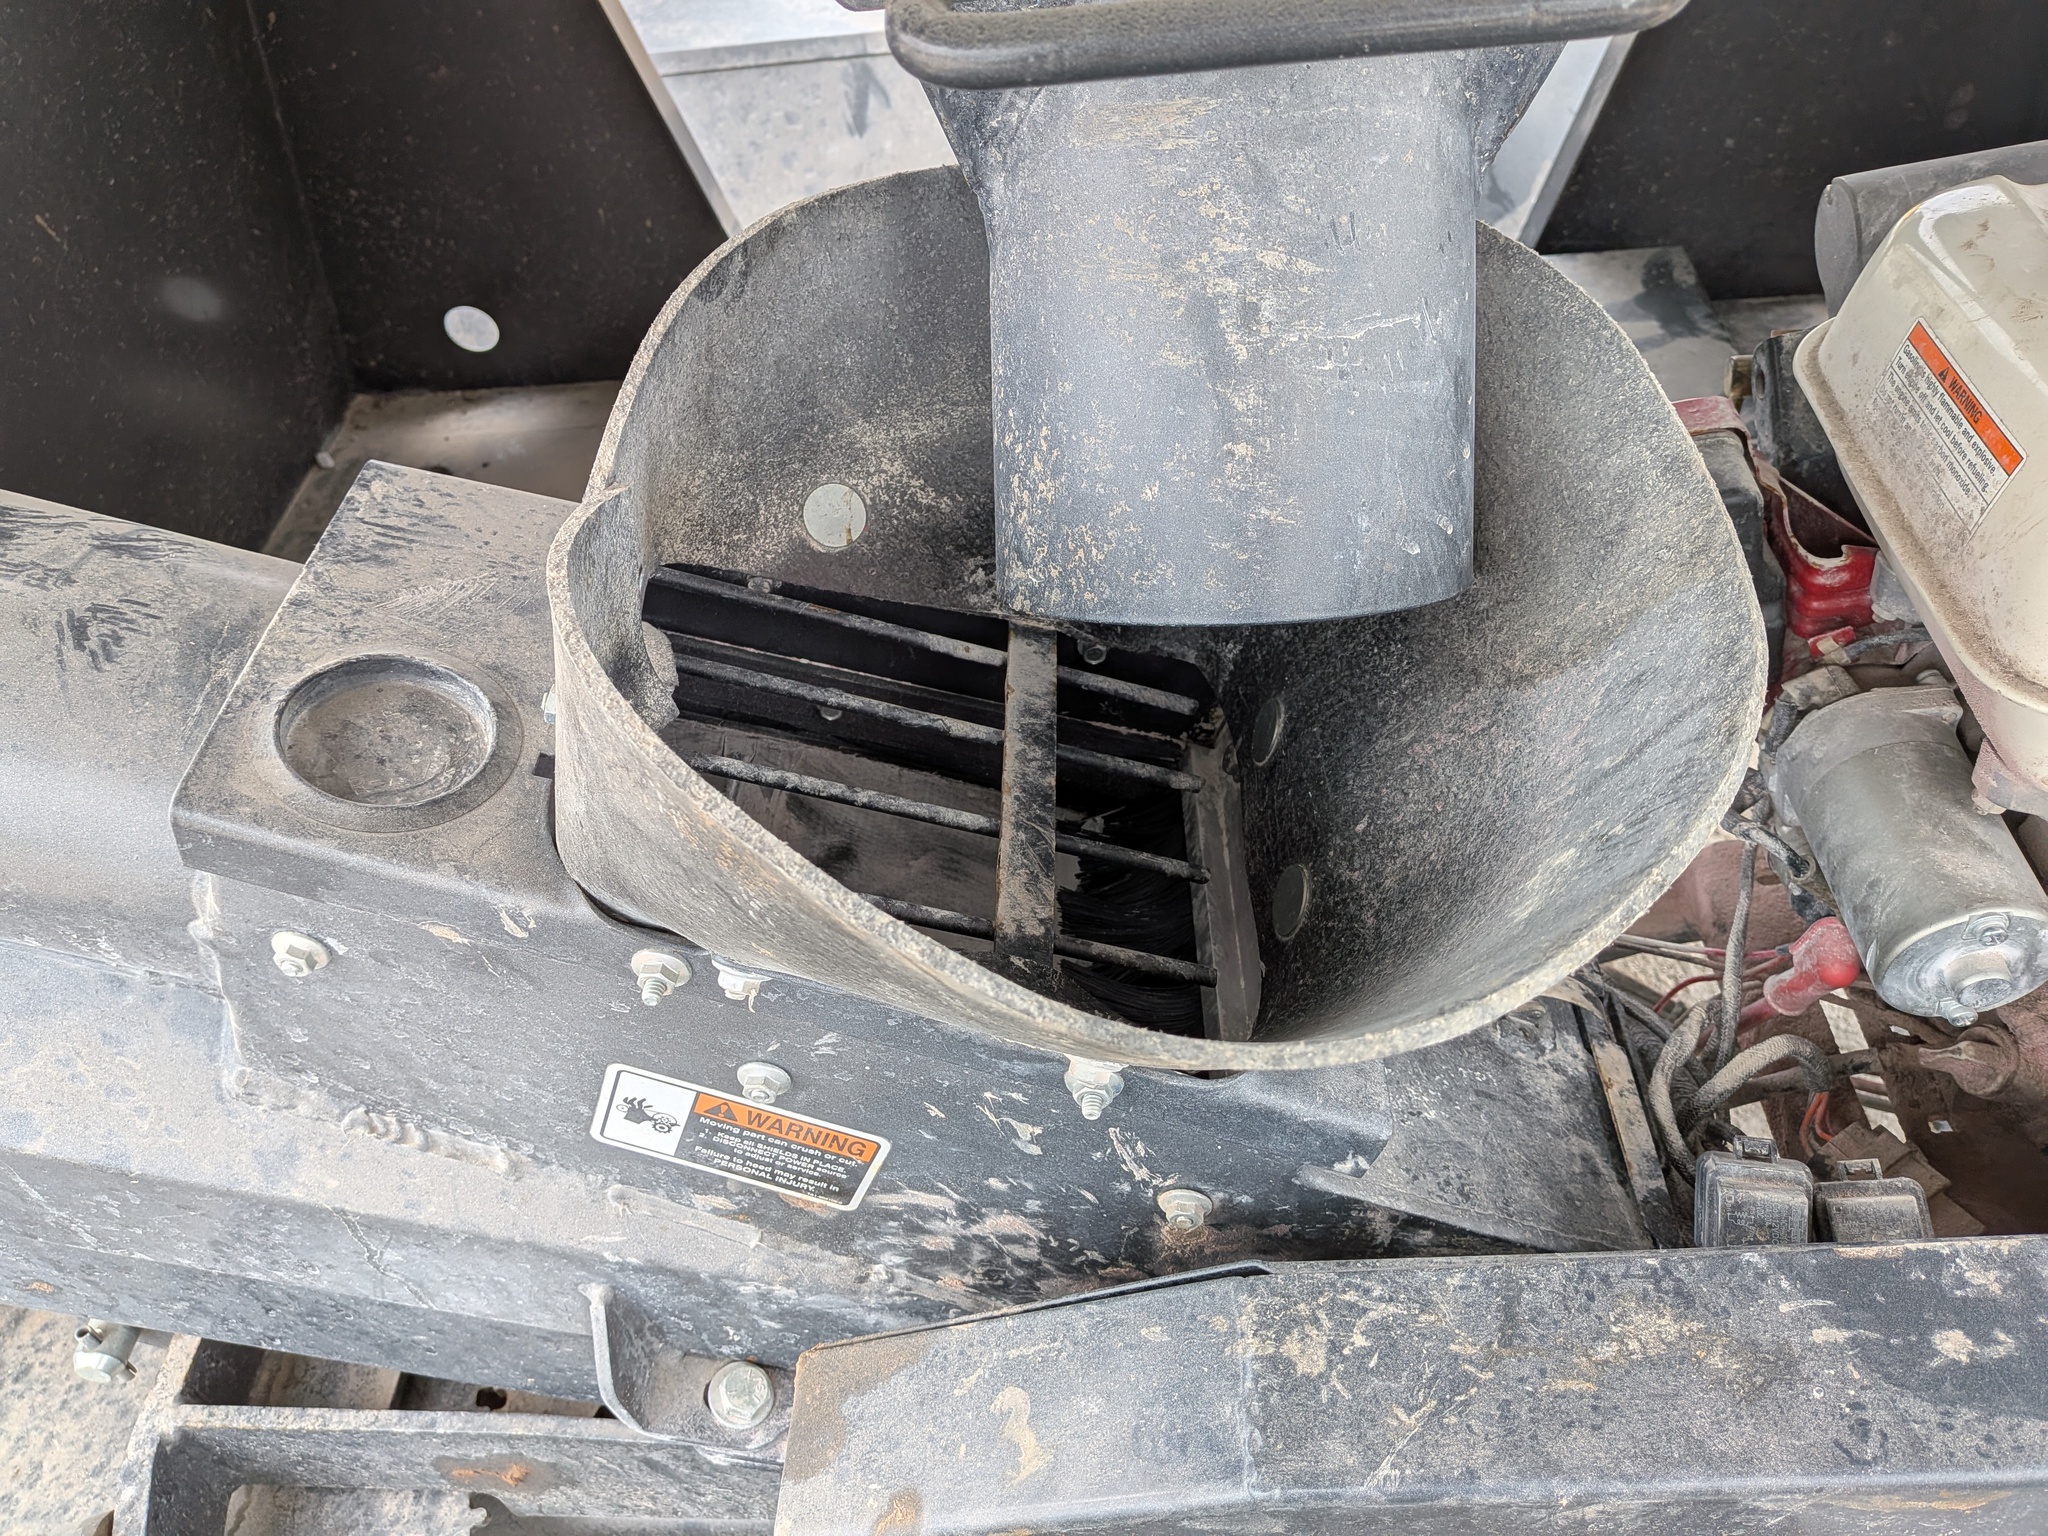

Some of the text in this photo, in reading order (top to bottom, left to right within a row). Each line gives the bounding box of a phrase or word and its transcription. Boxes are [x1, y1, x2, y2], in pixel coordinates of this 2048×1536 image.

[1886, 370, 1896, 387] The
[1894, 384, 1910, 410] engine
[1902, 343, 1923, 375] Gasolin
[1923, 372, 1939, 398] highly
[1937, 392, 1963, 430] flammable
[1961, 427, 1975, 444] and
[1971, 440, 1996, 477] explosive.
[1948, 375, 1983, 425] WARNING
[1895, 355, 1908, 375] Turn
[1918, 391, 1929, 403] off
[1924, 400, 1937, 416] and
[1933, 410, 1943, 425] let
[1940, 422, 1954, 439] cool
[1949, 433, 1967, 461] before
[1965, 457, 1989, 493] refueling.
[699, 1116, 740, 1134] Moving
[742, 1130, 766, 1140] part
[767, 1137, 788, 1147] can
[790, 1143, 822, 1157] crush
[838, 1157, 860, 1167] cut.
[712, 1135, 777, 1158] DISCONNECT
[778, 1154, 815, 1169] POWER
[815, 1166, 847, 1179] source
[717, 1131, 741, 1143] Keep
[756, 1142, 798, 1159] SHIELDS
[800, 1155, 811, 1163] IN
[812, 1159, 846, 1173] PLACE.
[747, 1109, 867, 1158] WARNING
[694, 1145, 839, 1192] Failure to heed may result in
[712, 1157, 815, 1192] PERSONAL INJURY.
[744, 1151, 773, 1163] adjust
[786, 1163, 821, 1177] service.
